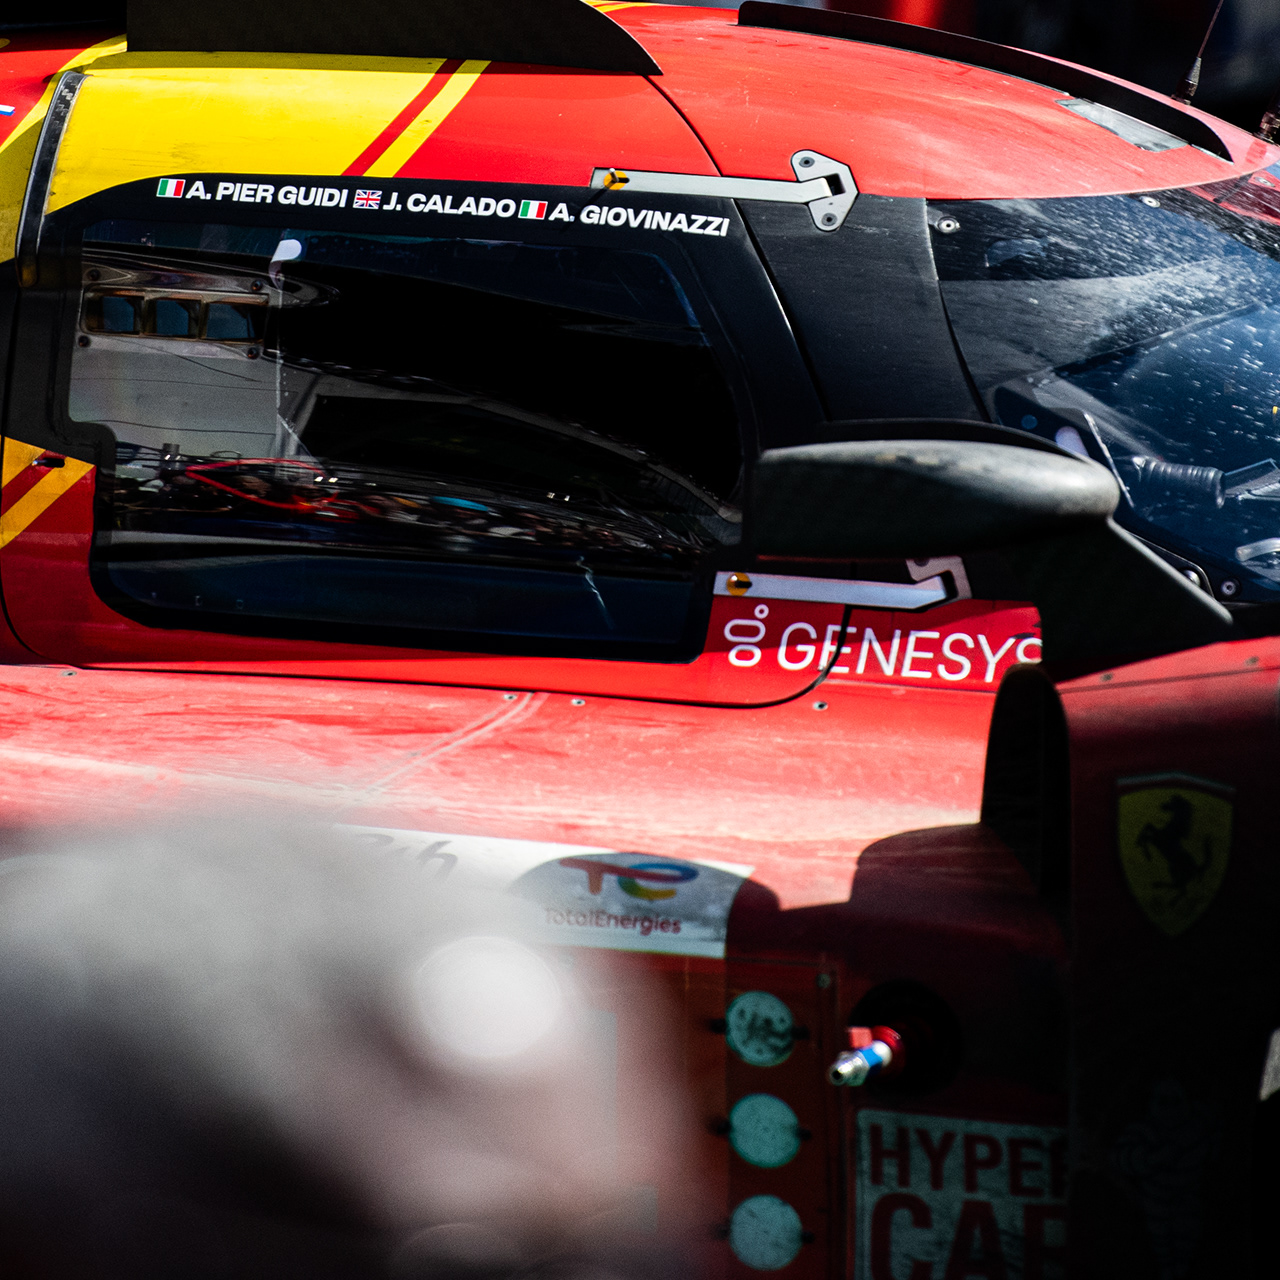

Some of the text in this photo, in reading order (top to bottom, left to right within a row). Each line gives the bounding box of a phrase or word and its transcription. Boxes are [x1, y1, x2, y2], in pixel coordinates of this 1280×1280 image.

[185, 180, 348, 208] A. PIER GUIDI
[382, 192, 516, 218] J. CALADO
[548, 202, 730, 237] A. GIOVINAZZI
[545, 909, 682, 936] TotalEnergies
